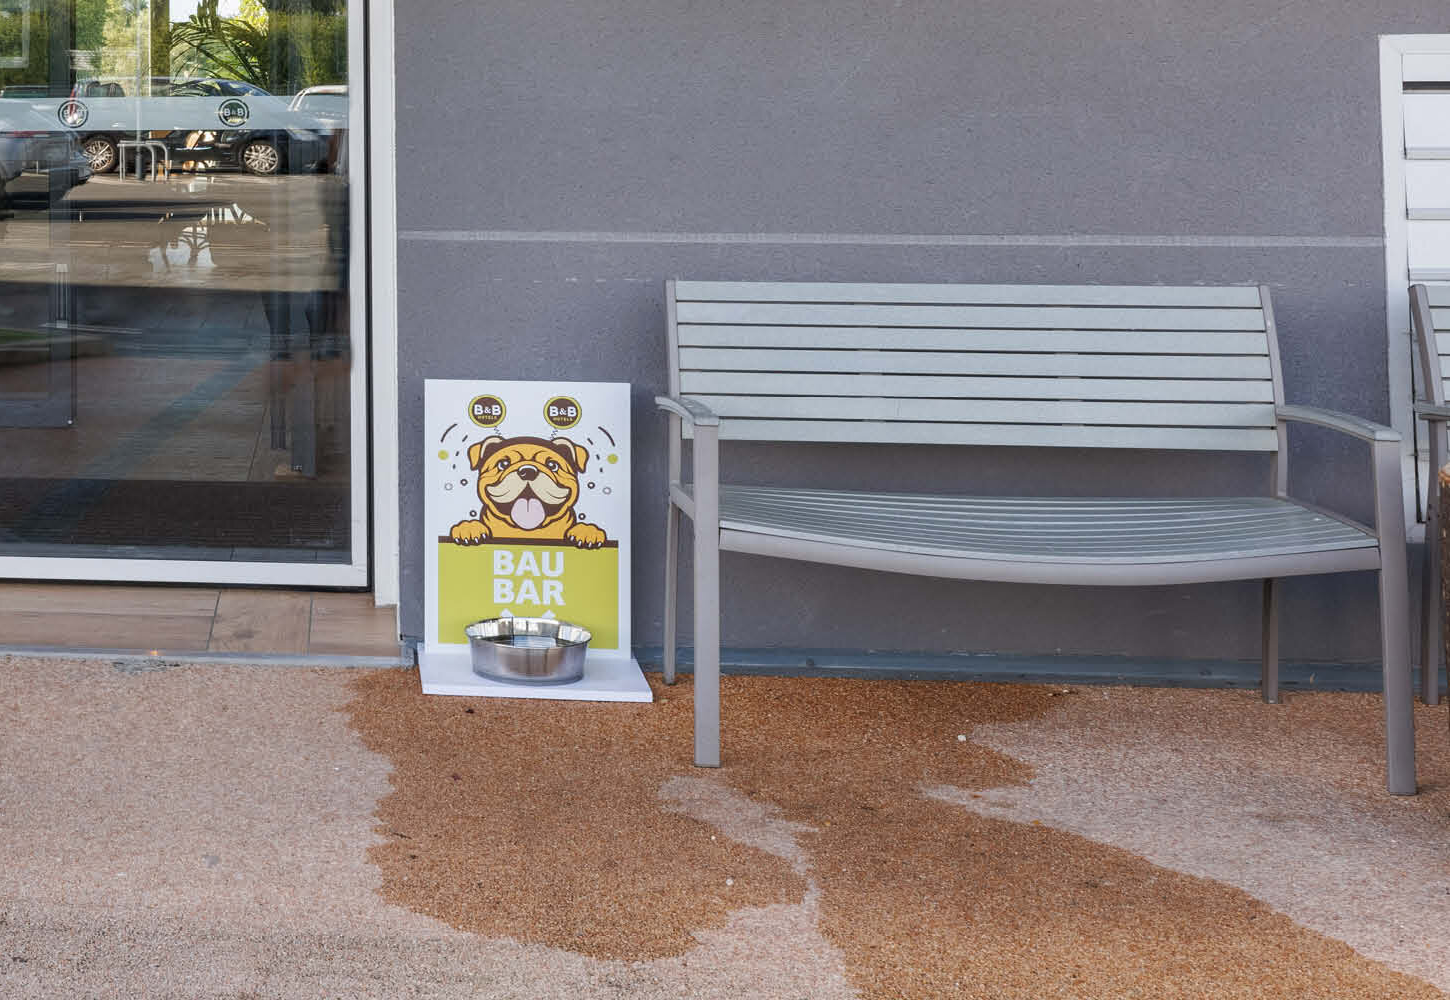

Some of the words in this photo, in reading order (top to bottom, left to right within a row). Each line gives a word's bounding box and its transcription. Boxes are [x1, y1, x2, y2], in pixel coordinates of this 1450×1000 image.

[473, 403, 502, 416] B&B
[549, 405, 577, 417] B&B
[493, 549, 564, 577] BAU
[493, 578, 566, 606] BAR
